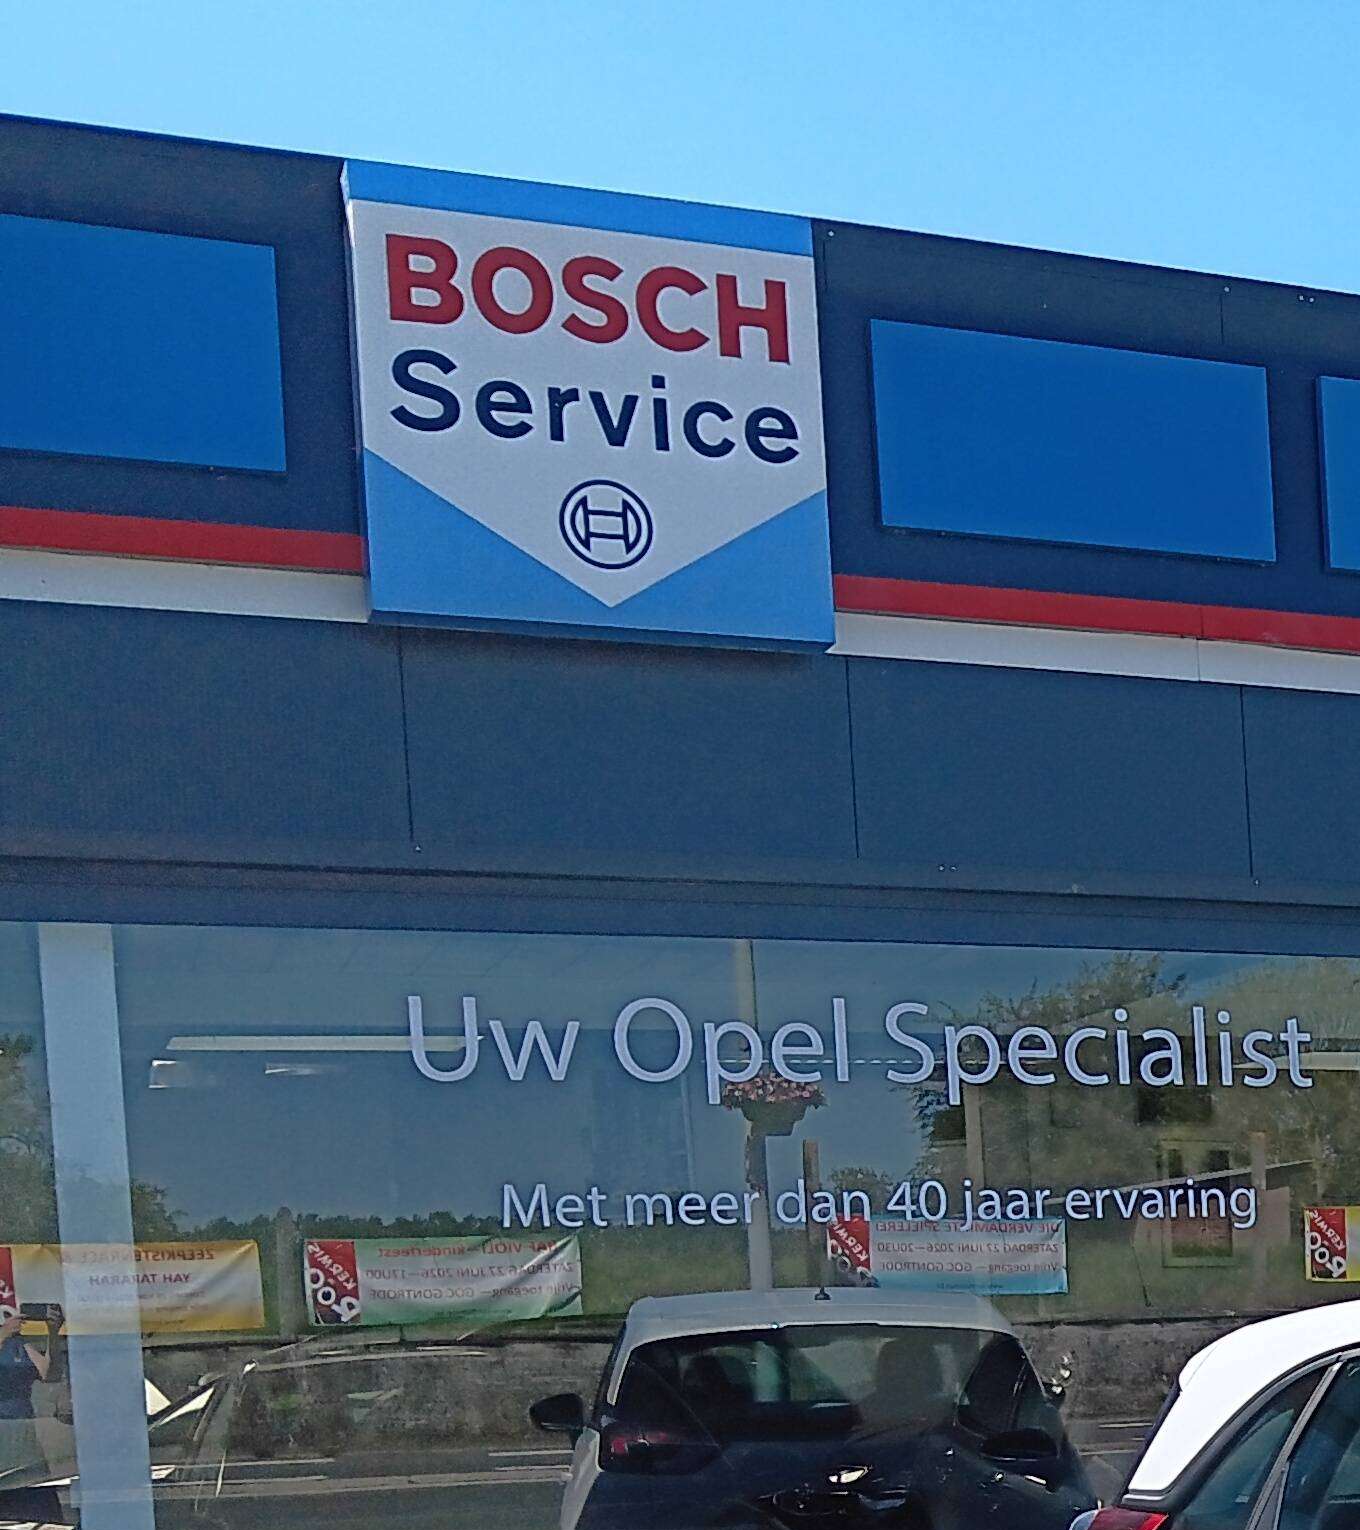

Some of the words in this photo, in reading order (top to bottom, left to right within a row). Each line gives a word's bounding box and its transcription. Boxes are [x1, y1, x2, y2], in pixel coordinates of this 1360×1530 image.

[385, 233, 791, 364] BOSCH
[390, 349, 800, 464] Service
[406, 995, 580, 1083] Uw
[612, 996, 850, 1107] Opel
[885, 1001, 1314, 1108] Specialist
[501, 1181, 608, 1230] Met
[623, 1190, 760, 1229] meer
[775, 1180, 872, 1224] dan
[886, 1180, 950, 1223] 40
[959, 1180, 1055, 1232] jaar
[1065, 1178, 1258, 1232] ervaring
